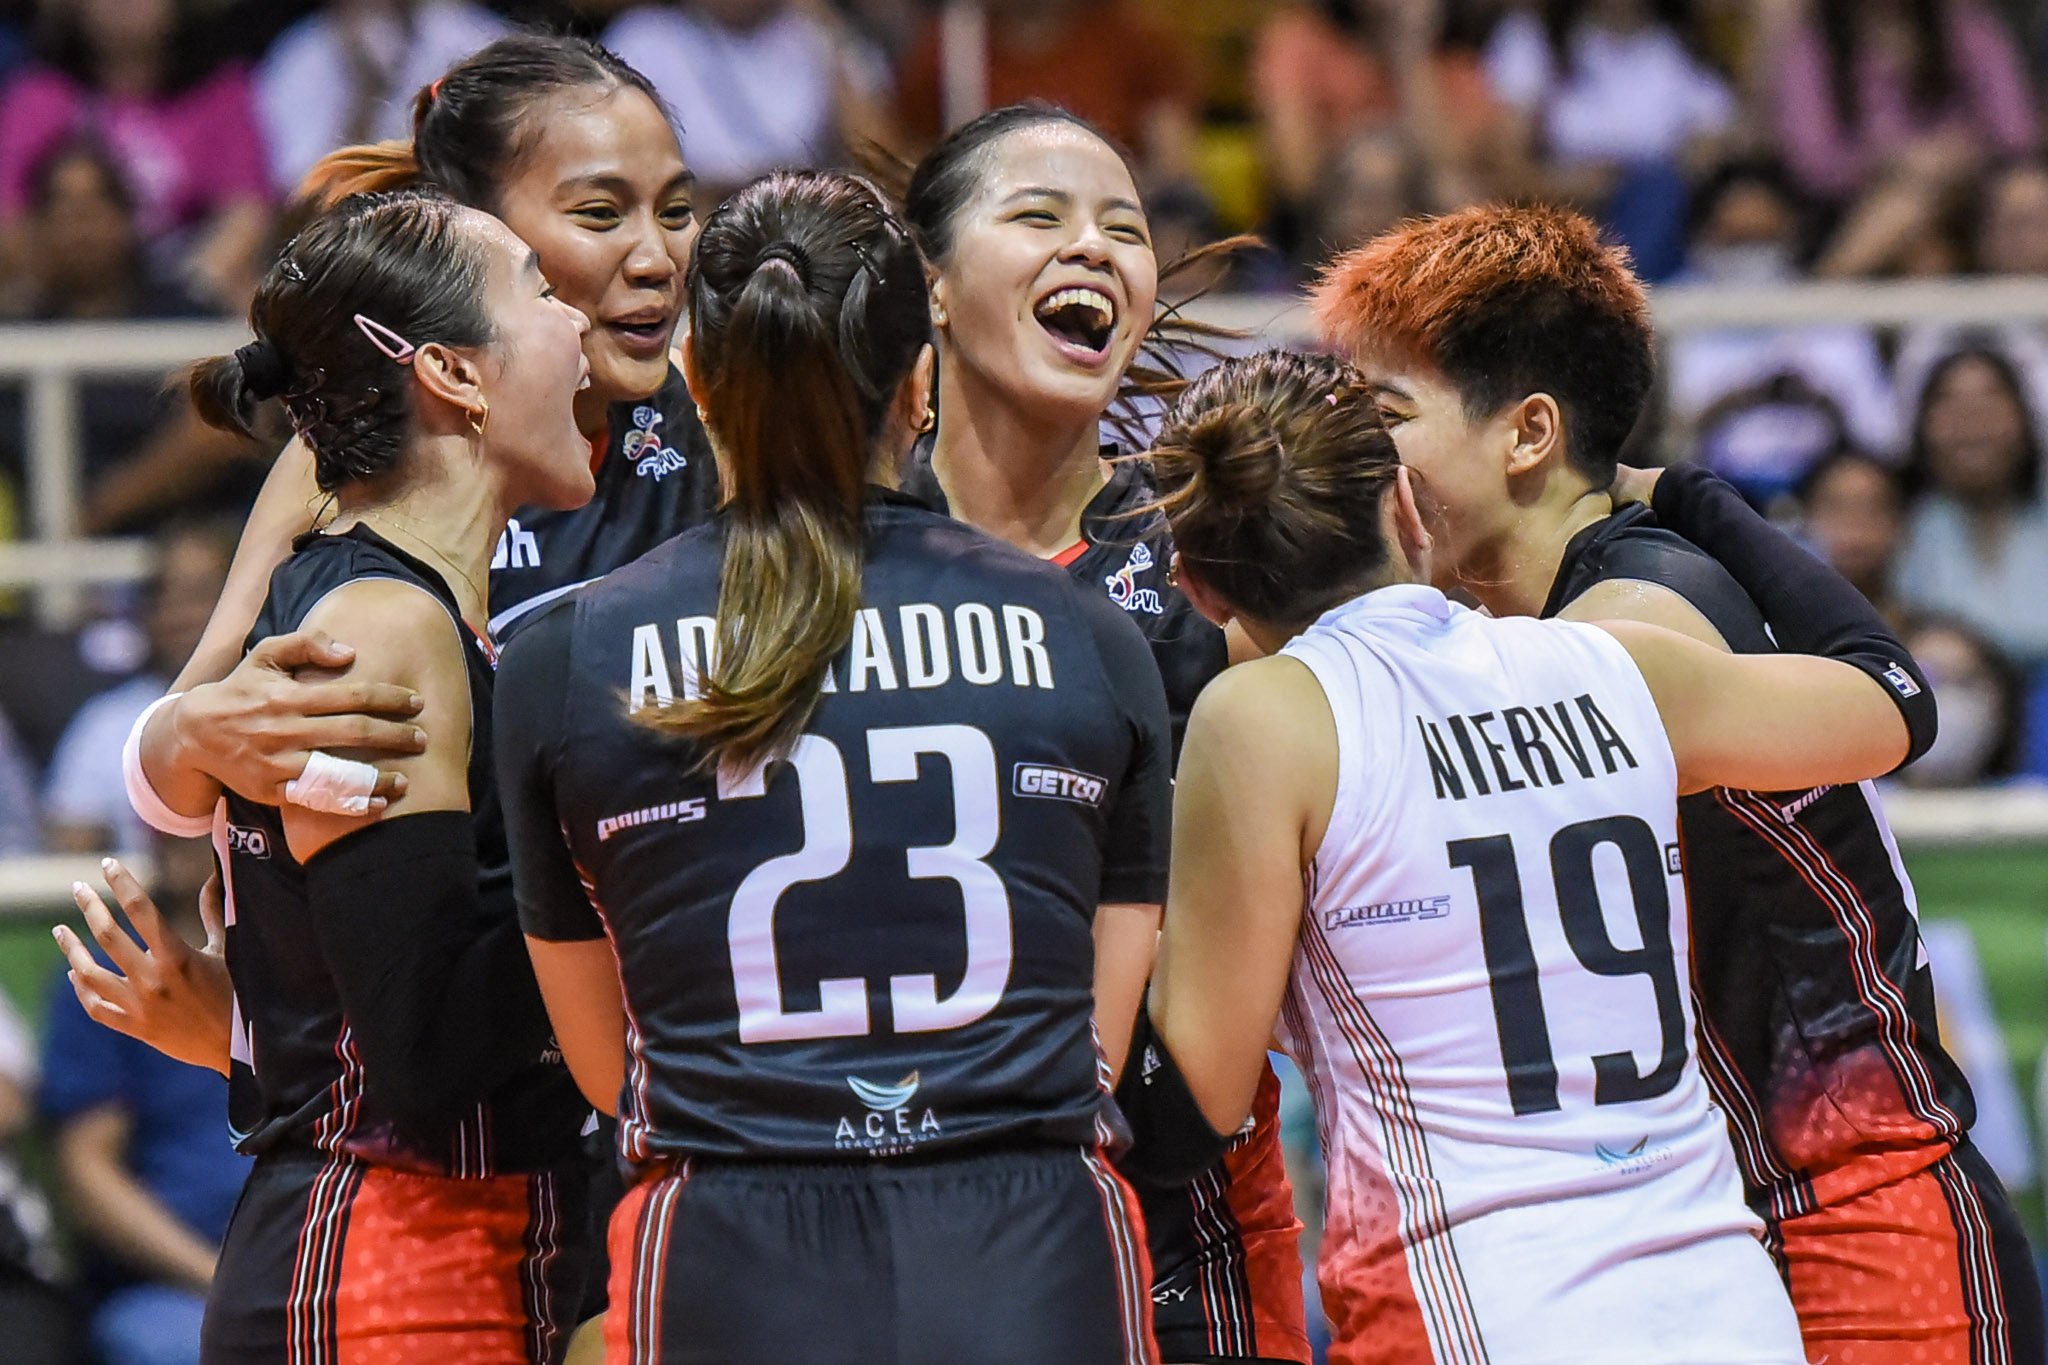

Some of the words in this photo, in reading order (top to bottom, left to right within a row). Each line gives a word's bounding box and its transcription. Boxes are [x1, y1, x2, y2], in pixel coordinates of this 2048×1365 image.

[1131, 589, 1163, 614] PVL
[629, 602, 1054, 714] ADADOR
[1416, 694, 1639, 800] NIERVA
[717, 725, 1014, 1044] 23
[1446, 815, 1689, 1116] 19
[835, 1108, 940, 1140] ACEA
